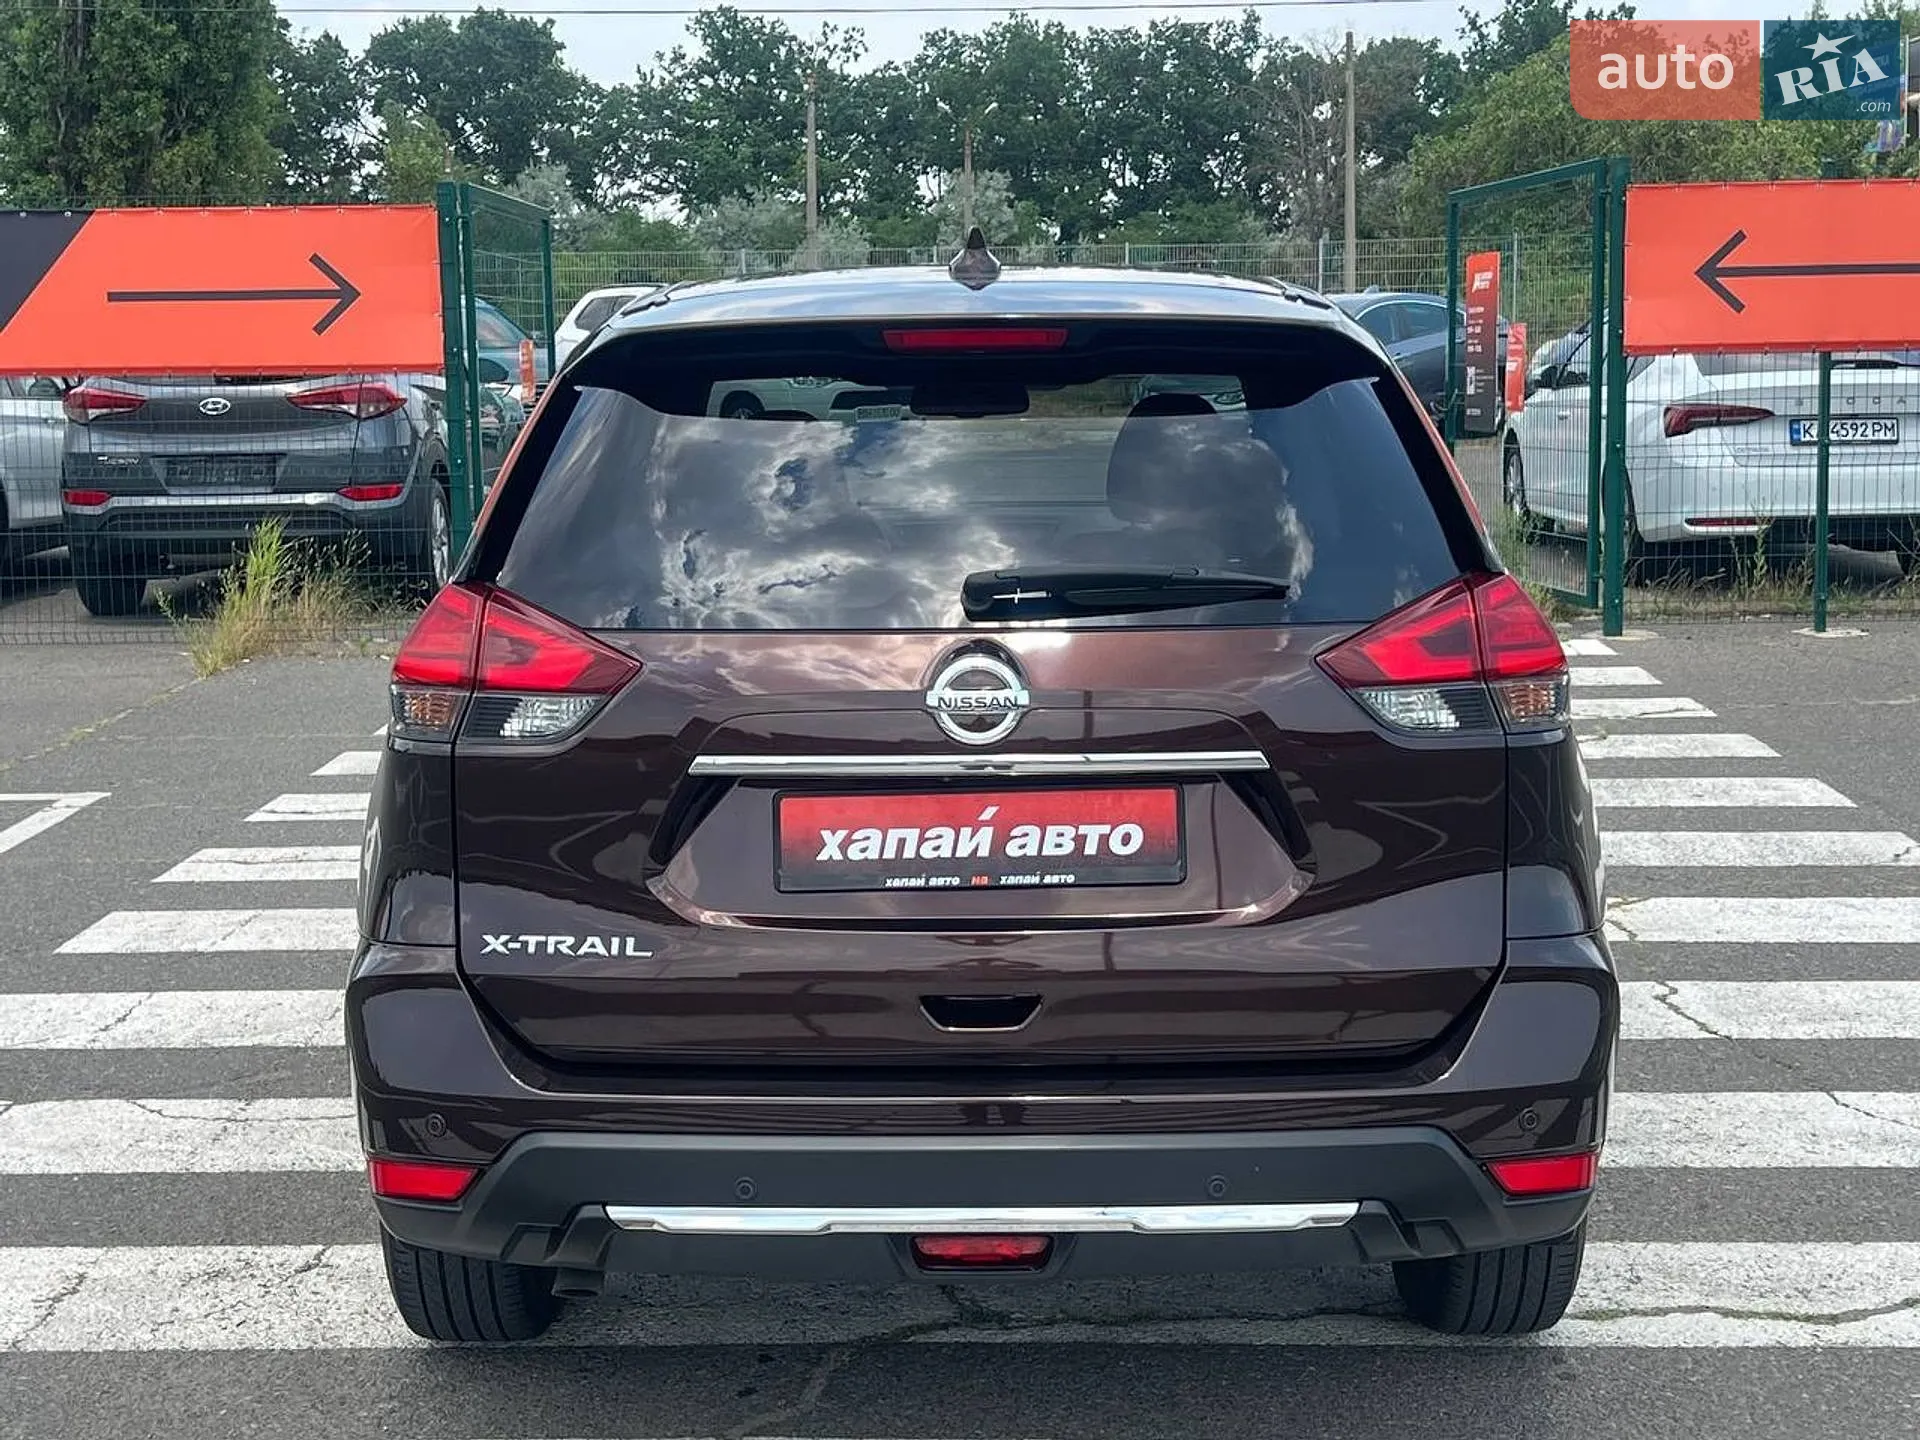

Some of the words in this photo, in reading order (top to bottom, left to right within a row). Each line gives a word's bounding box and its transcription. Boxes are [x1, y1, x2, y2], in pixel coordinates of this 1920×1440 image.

[1830, 422, 1869, 437] 4592
[937, 696, 1018, 709] NISSAN
[1005, 823, 1144, 857] авто
[928, 876, 961, 886] авто
[1043, 874, 1076, 884] авто
[480, 934, 653, 957] X-TRAIL
